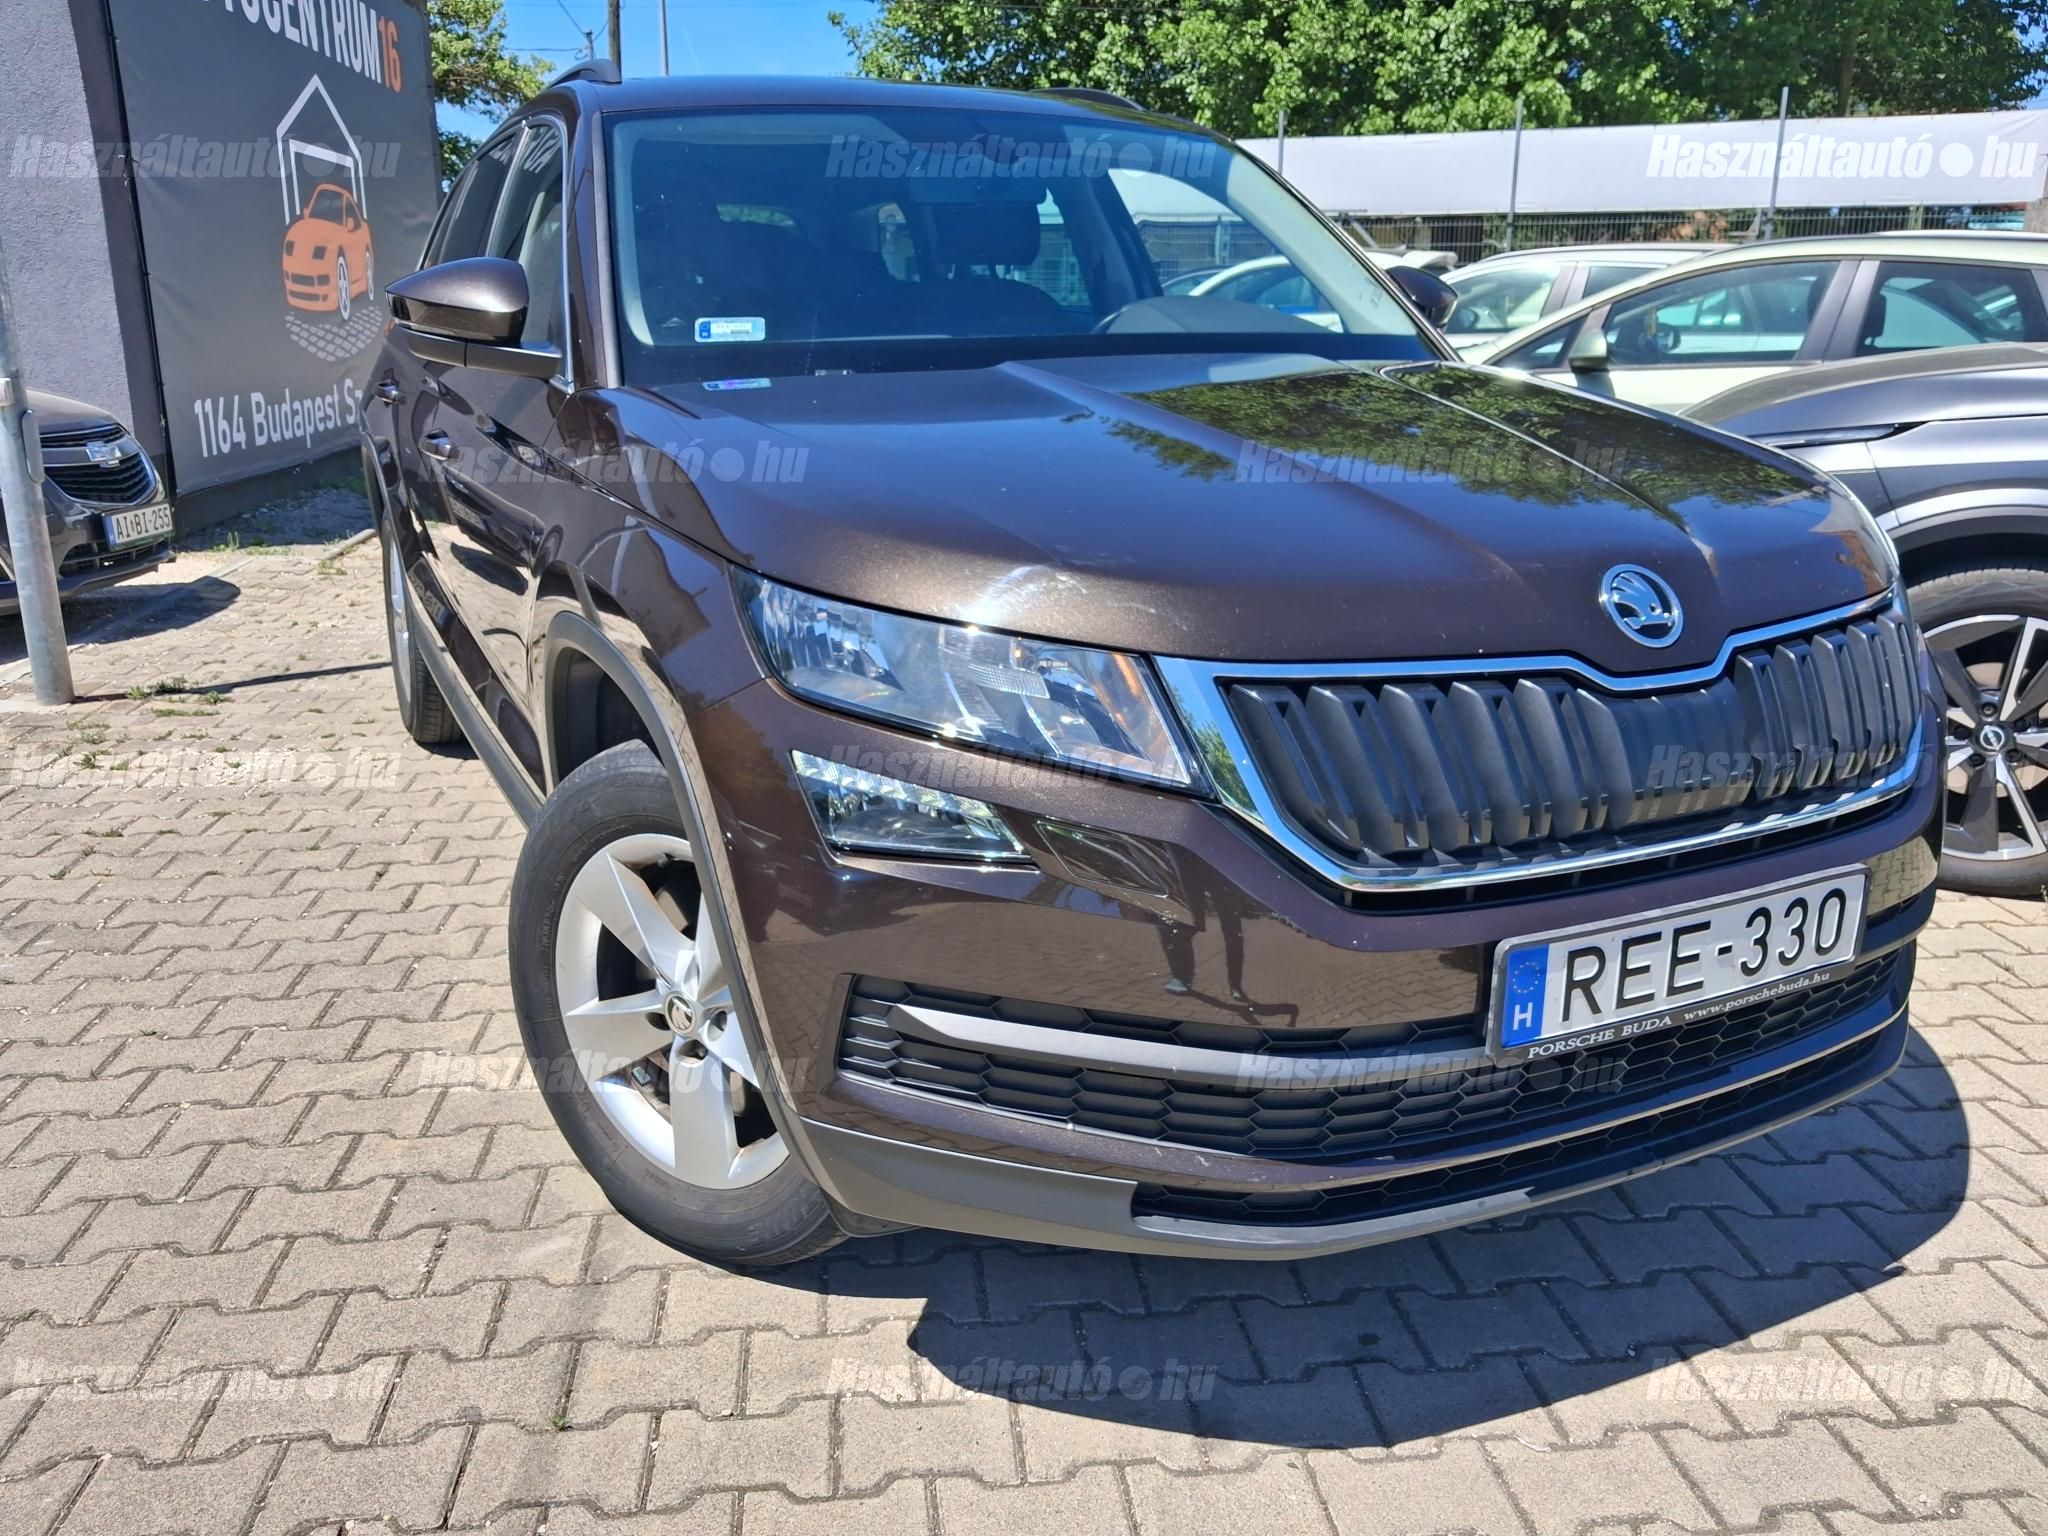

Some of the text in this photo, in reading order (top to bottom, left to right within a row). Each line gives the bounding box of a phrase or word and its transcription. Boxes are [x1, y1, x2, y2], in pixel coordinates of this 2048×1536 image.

[194, 394, 246, 458] 1164
[250, 384, 341, 449] Budapest
[1562, 887, 1847, 1023] REE-330
[1512, 1002, 1532, 1031] H
[1528, 972, 1831, 1059] PORSCHE BUDA www.porschebuda.hu
